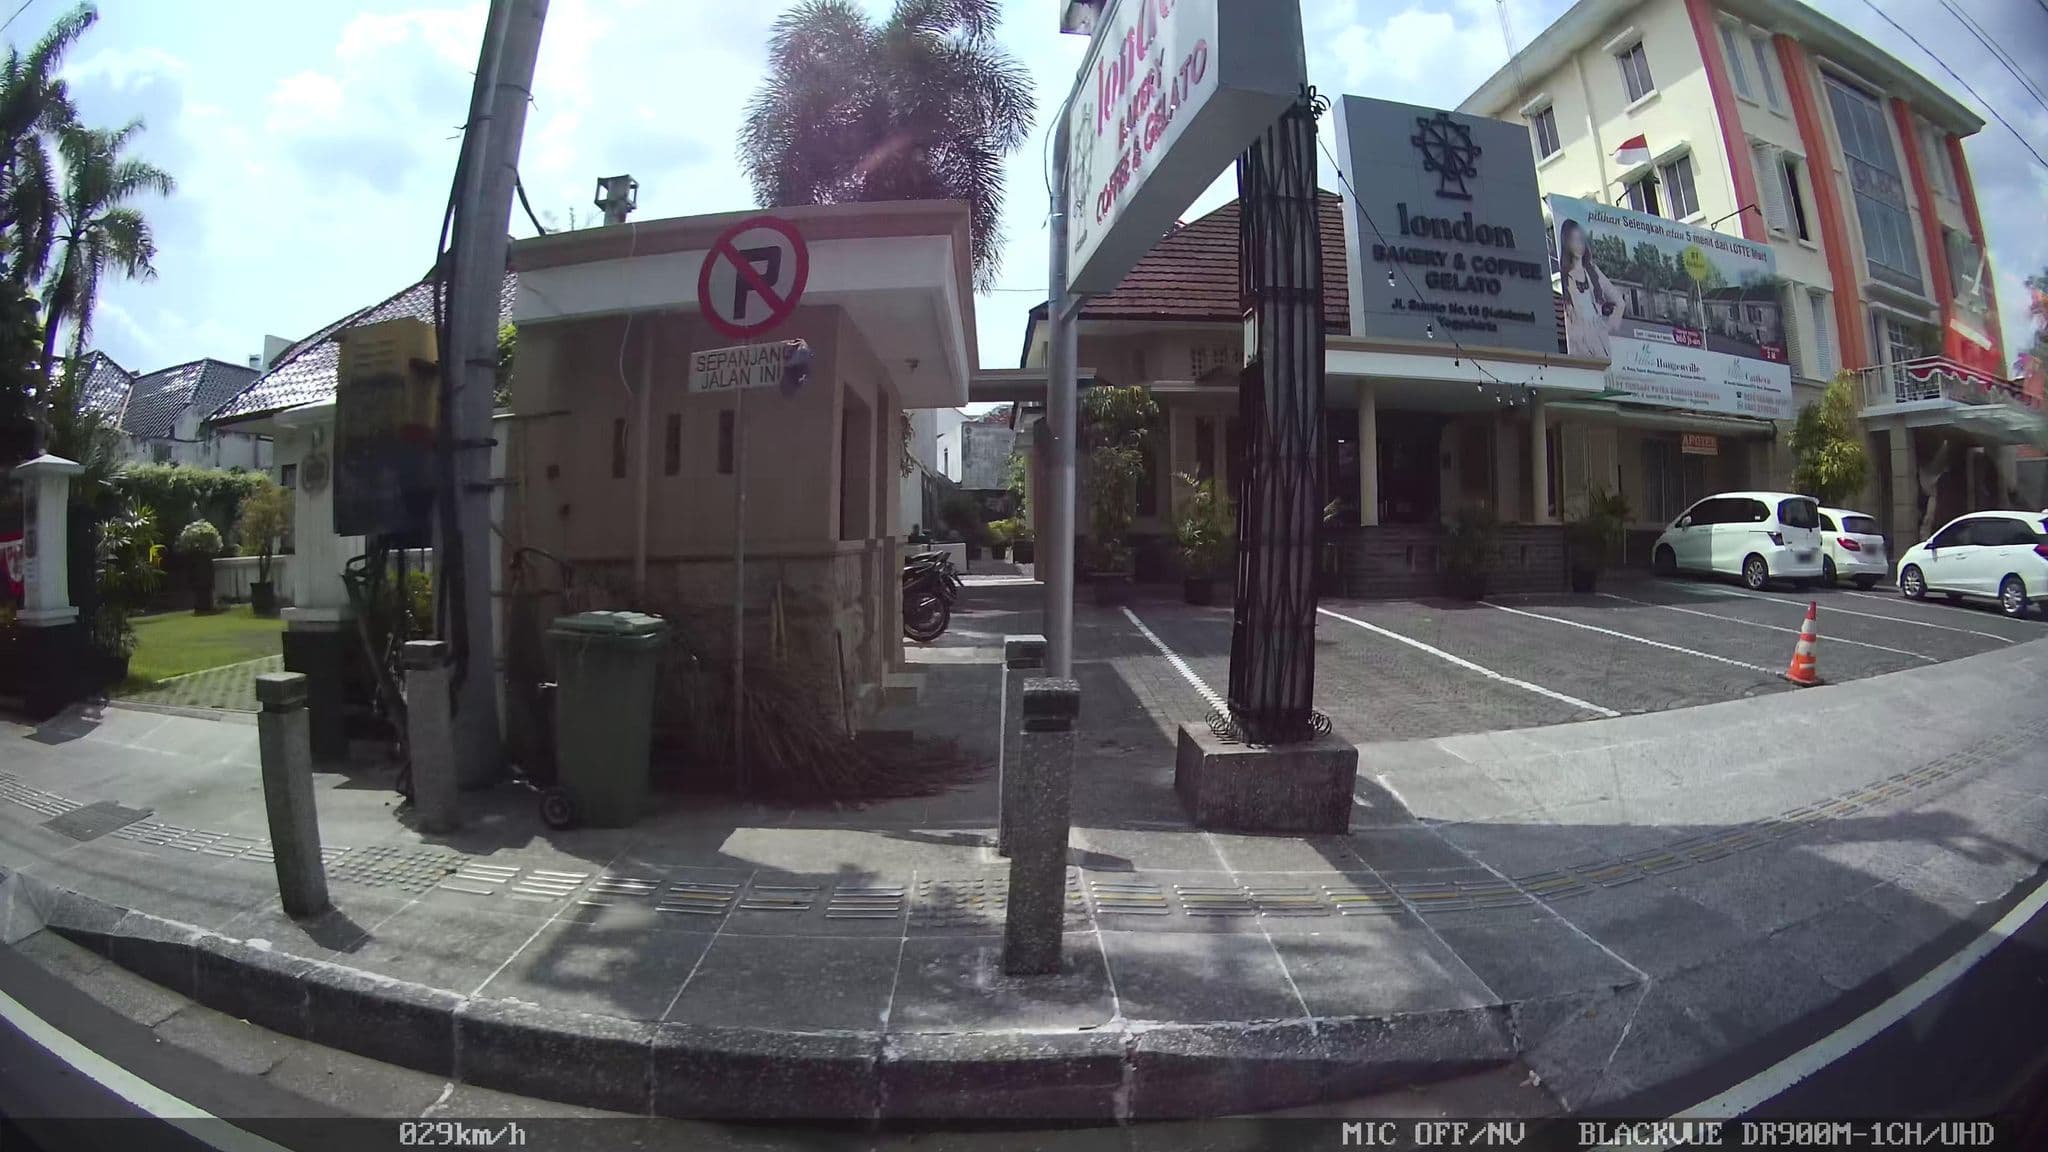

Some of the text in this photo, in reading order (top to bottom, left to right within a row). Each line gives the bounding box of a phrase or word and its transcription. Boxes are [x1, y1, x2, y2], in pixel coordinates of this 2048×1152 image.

[1397, 202, 1516, 249] london
[1587, 211, 1621, 226] pilihan
[1622, 216, 1665, 235] Selengkah
[1685, 231, 1692, 242] 5
[1372, 244, 1448, 268] BAKERY
[1453, 253, 1467, 271] &
[1425, 271, 1503, 296] GELATO
[701, 365, 780, 390] JALAN INI
